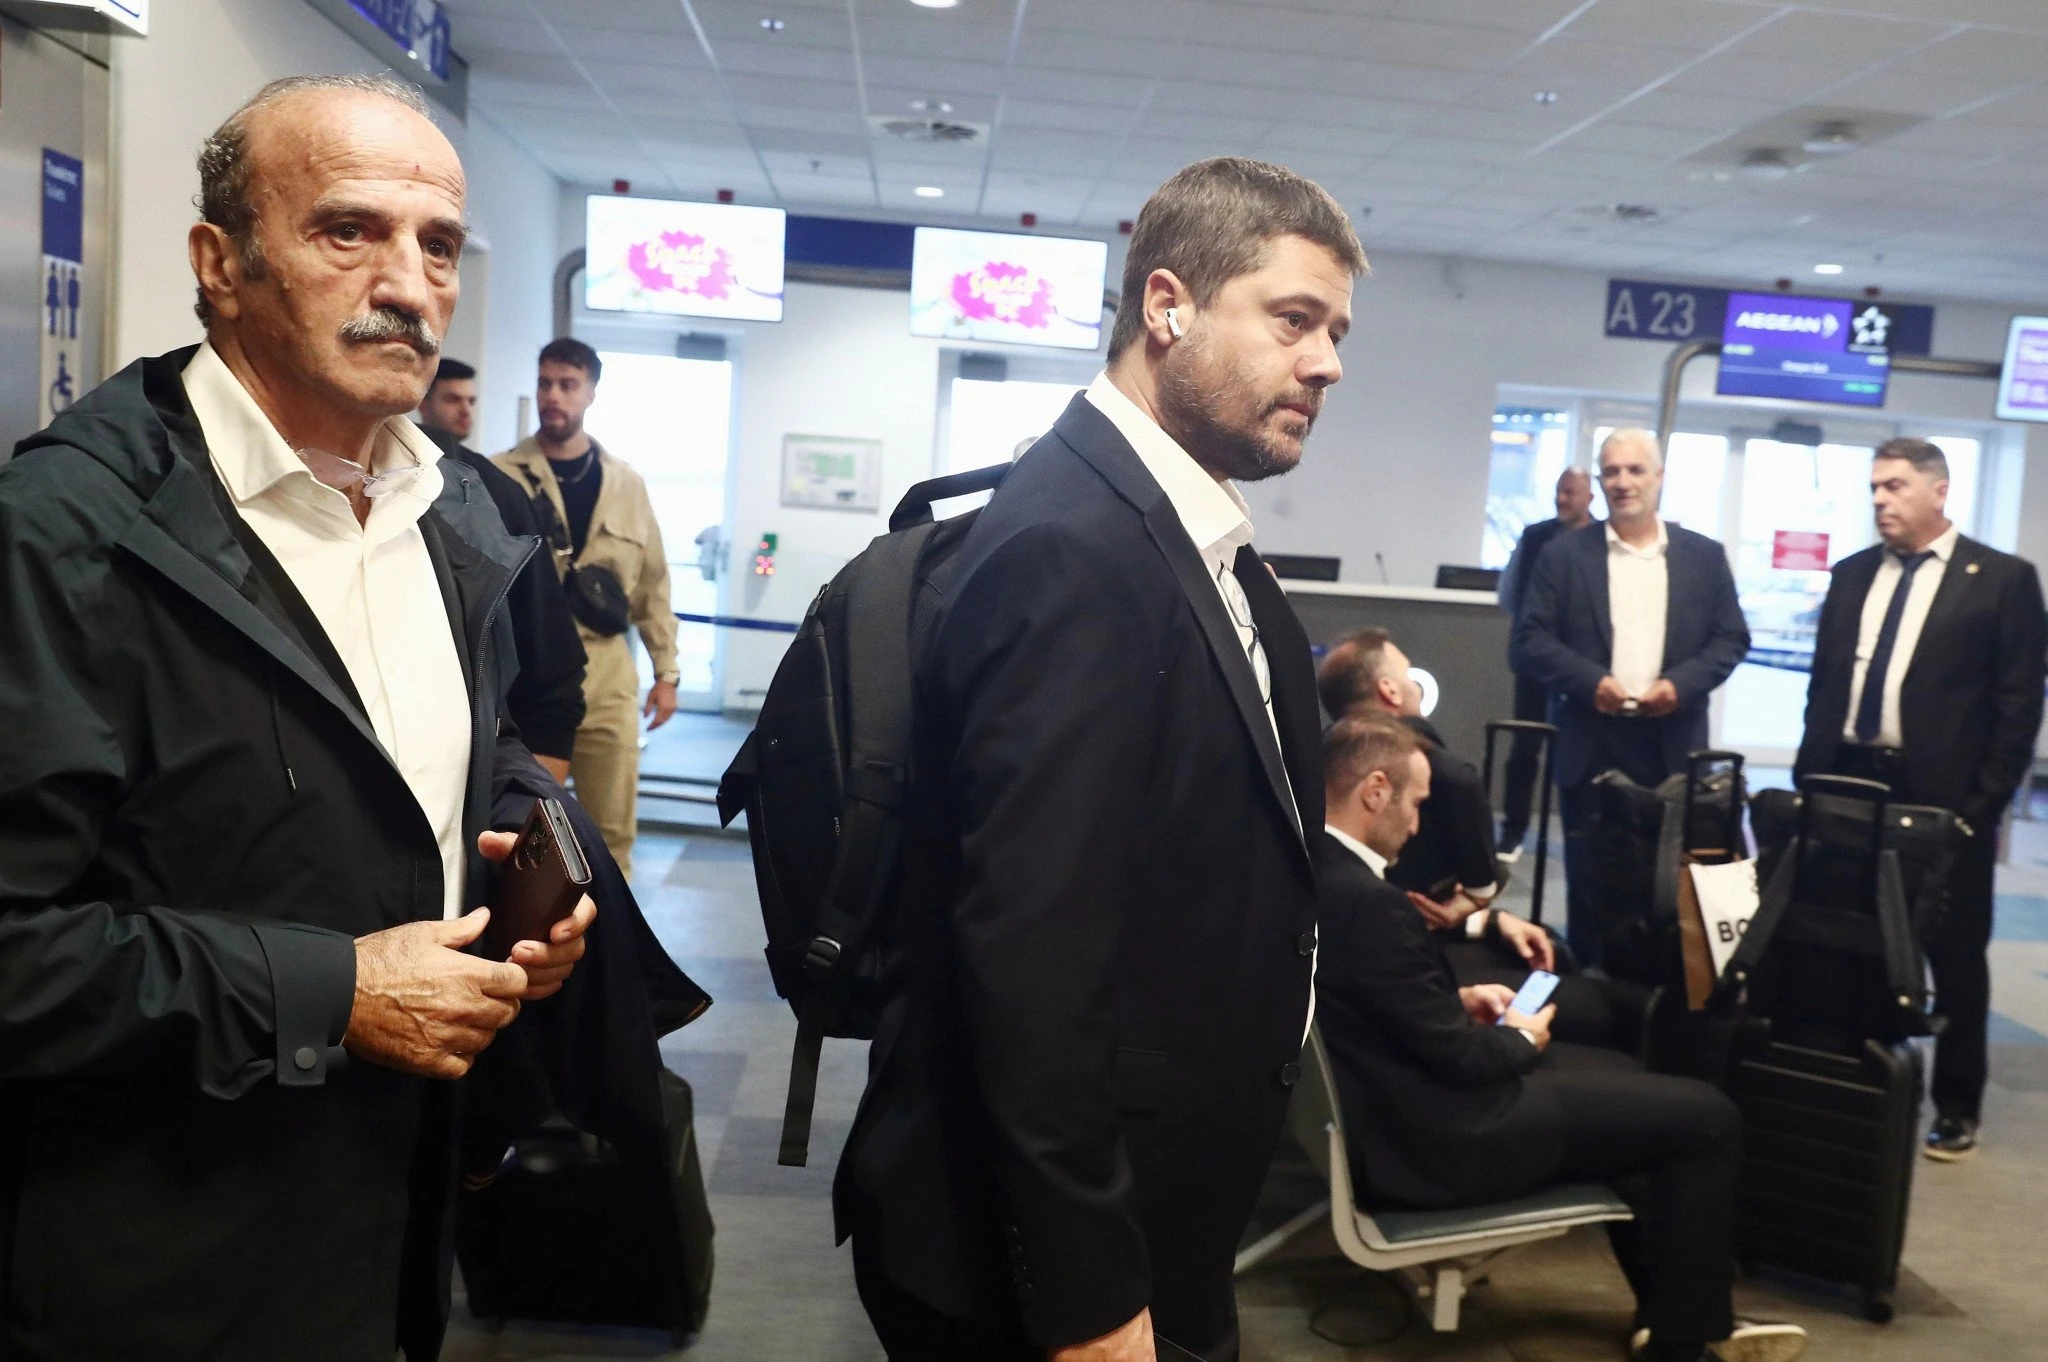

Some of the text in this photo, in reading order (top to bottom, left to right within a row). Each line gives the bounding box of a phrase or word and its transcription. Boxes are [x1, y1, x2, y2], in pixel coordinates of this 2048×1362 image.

[1609, 288, 1697, 336] A 23
[1735, 311, 1821, 334] AEGEAN
